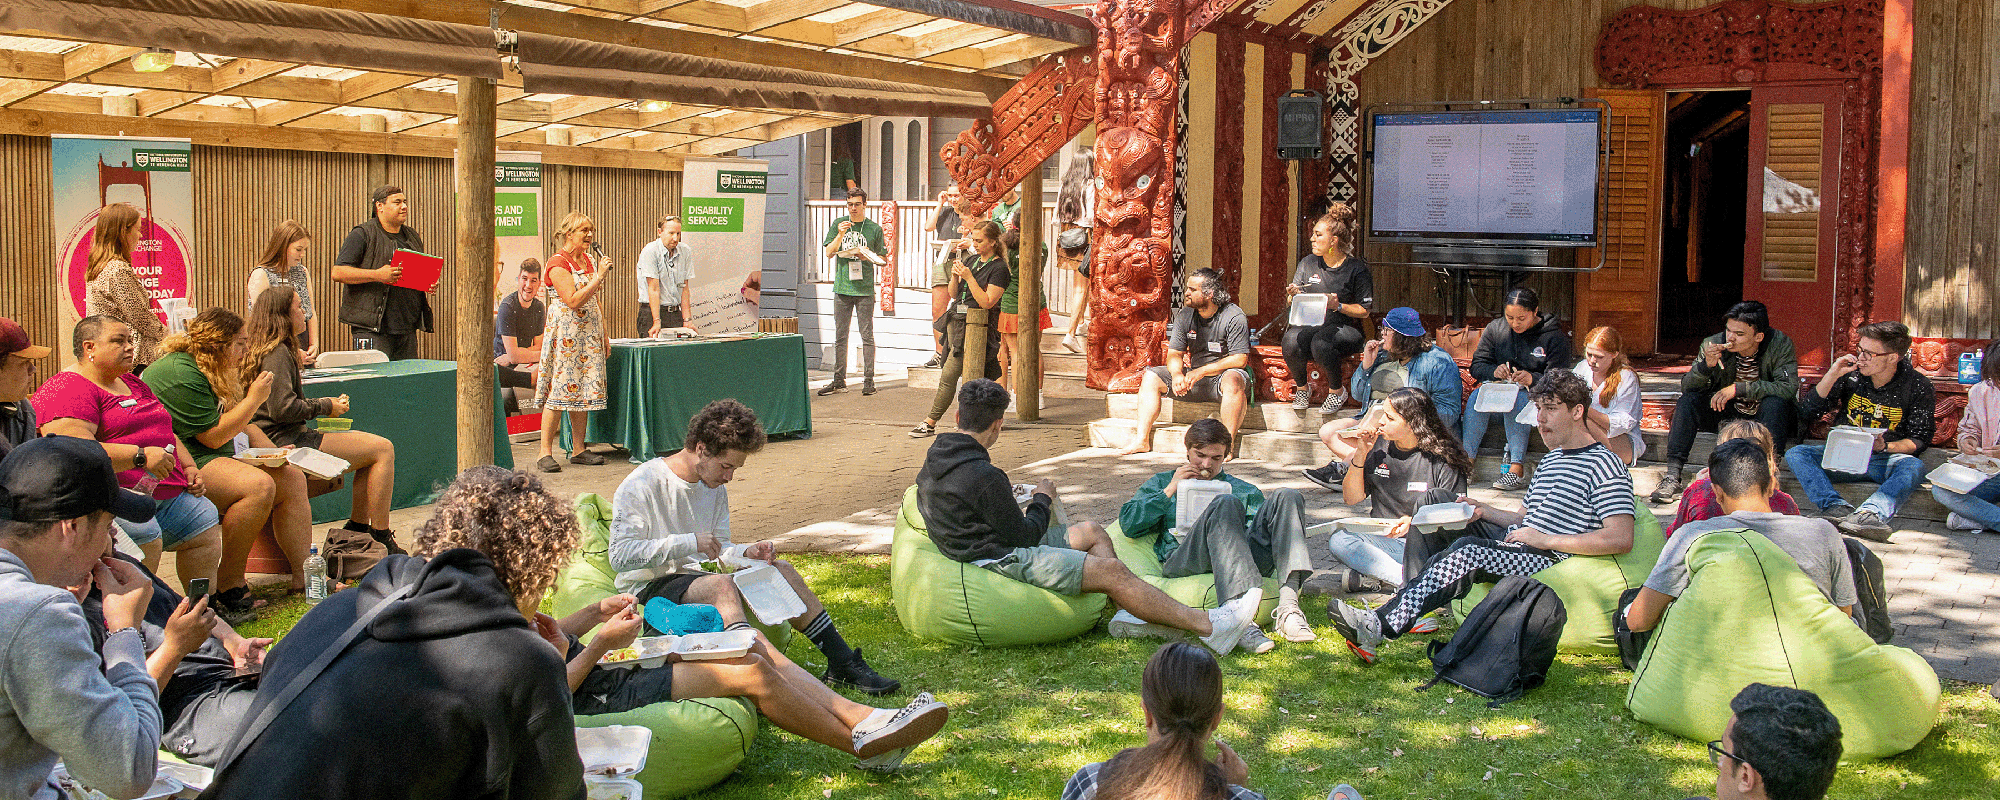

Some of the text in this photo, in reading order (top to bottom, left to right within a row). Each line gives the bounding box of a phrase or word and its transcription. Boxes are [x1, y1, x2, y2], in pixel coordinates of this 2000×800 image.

[1284, 113, 1315, 122] MIPRO
[504, 205, 524, 214] AND
[688, 206, 734, 215] DISABILITY
[495, 217, 523, 226] YMENT
[688, 216, 729, 225] SERVICES
[132, 266, 163, 275] YOUR
[138, 277, 159, 287] NGE
